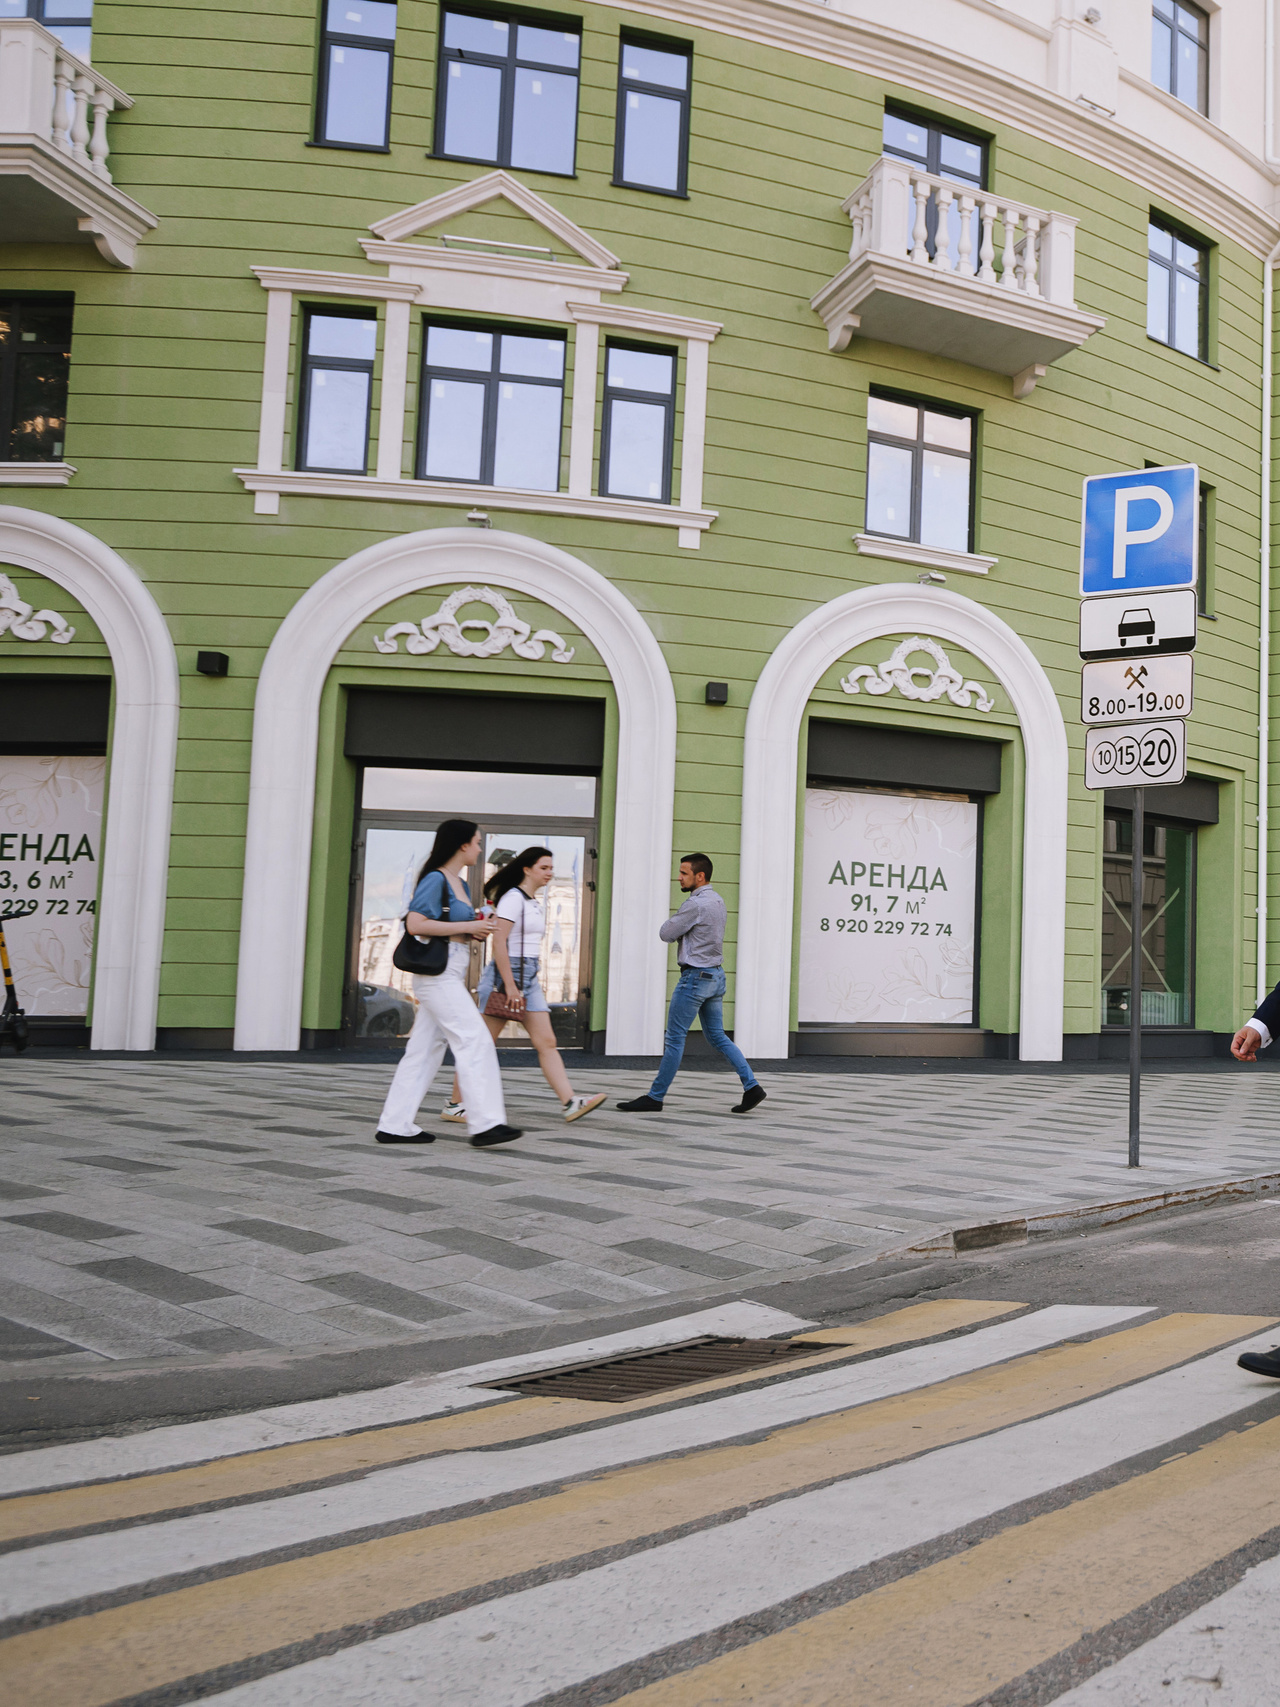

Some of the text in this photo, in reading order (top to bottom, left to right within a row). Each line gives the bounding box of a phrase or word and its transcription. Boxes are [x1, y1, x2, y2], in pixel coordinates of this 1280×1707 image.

[1112, 485, 1174, 579] P
[1088, 691, 1185, 717] 8.00-19.00
[1098, 739, 1171, 767] 10 15 20
[828, 860, 948, 893] АРЕНДА
[1, 899, 97, 915] 229 72 74
[886, 895, 899, 914] 7
[820, 918, 952, 937] 8 920 229 72 74
